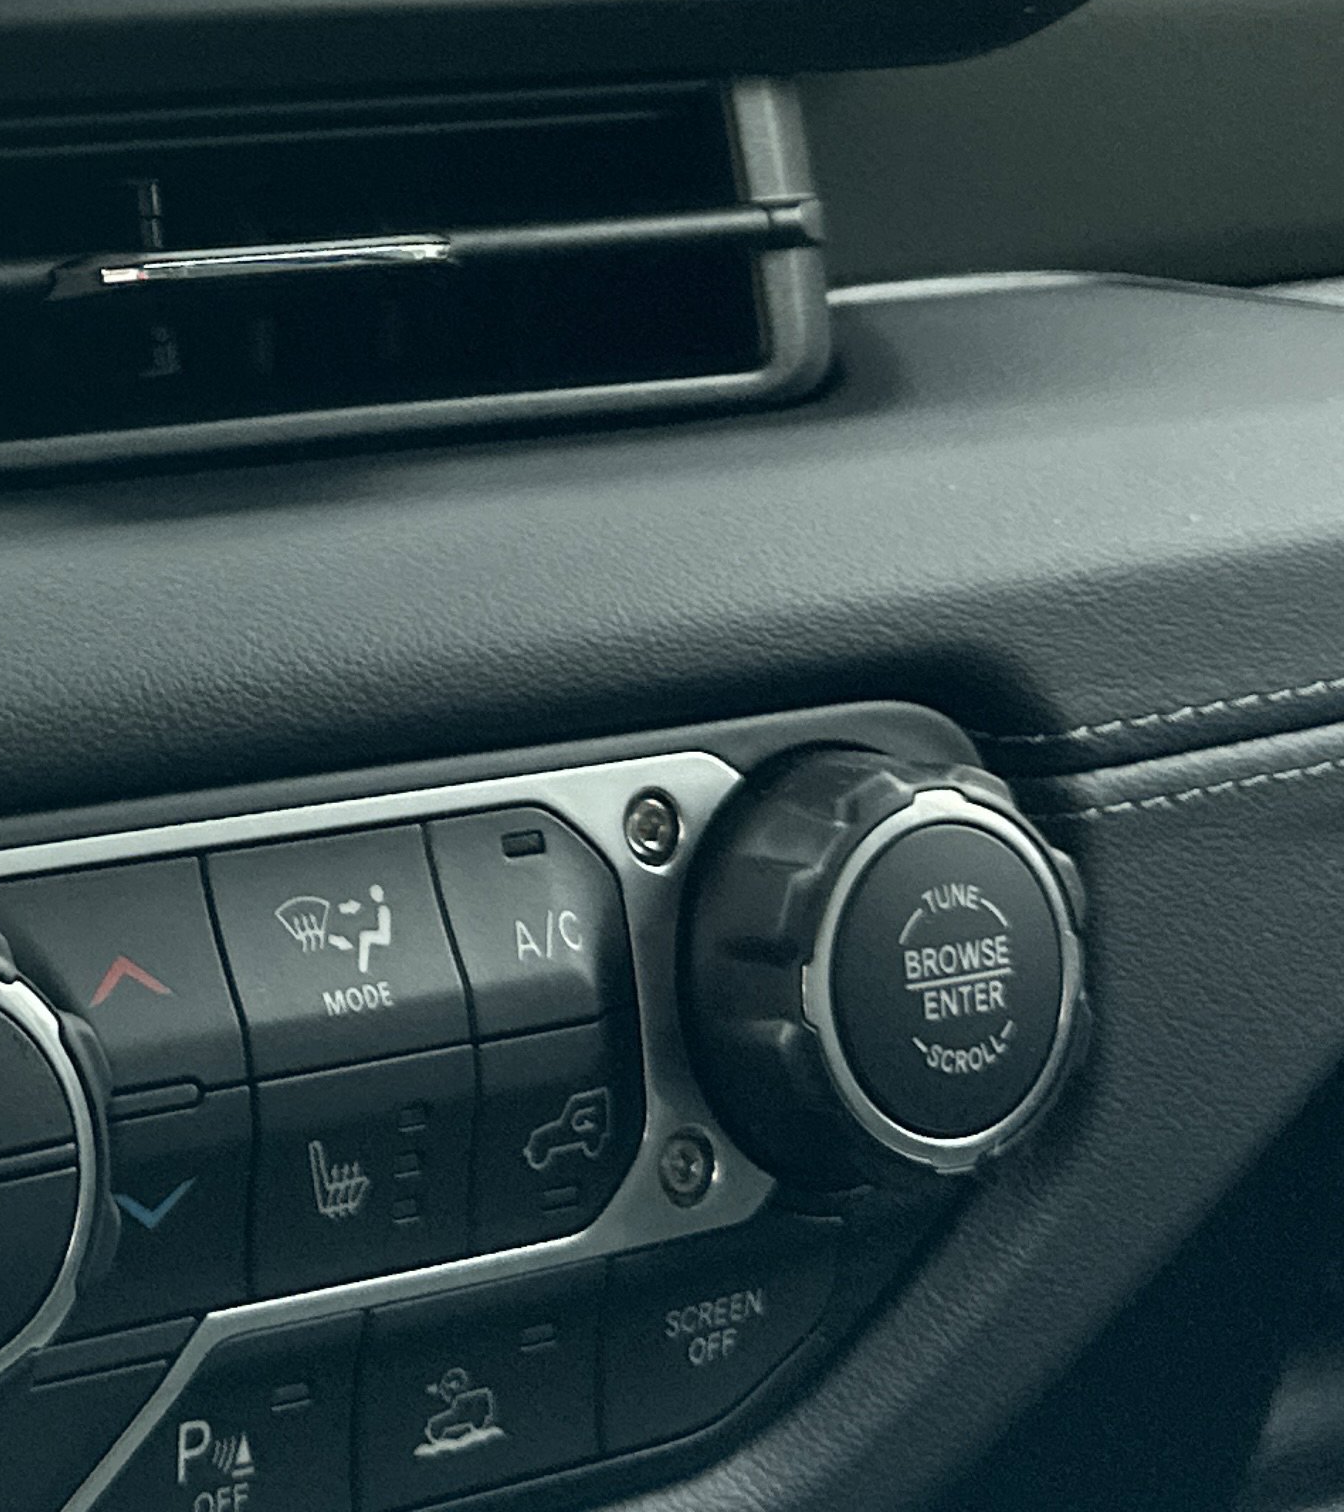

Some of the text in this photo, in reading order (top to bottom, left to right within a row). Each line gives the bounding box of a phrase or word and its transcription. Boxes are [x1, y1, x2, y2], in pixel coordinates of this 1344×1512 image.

[921, 883, 981, 913] TUNE
[514, 909, 584, 961] A/C
[904, 935, 1011, 980] BROWSE
[321, 980, 395, 1017] MODE
[922, 979, 1006, 1022] ENTER
[925, 1032, 1009, 1075] SCROLL
[664, 1289, 765, 1340] SCREEN
[687, 1328, 738, 1366] OFF
[193, 1482, 250, 1512] OFF
